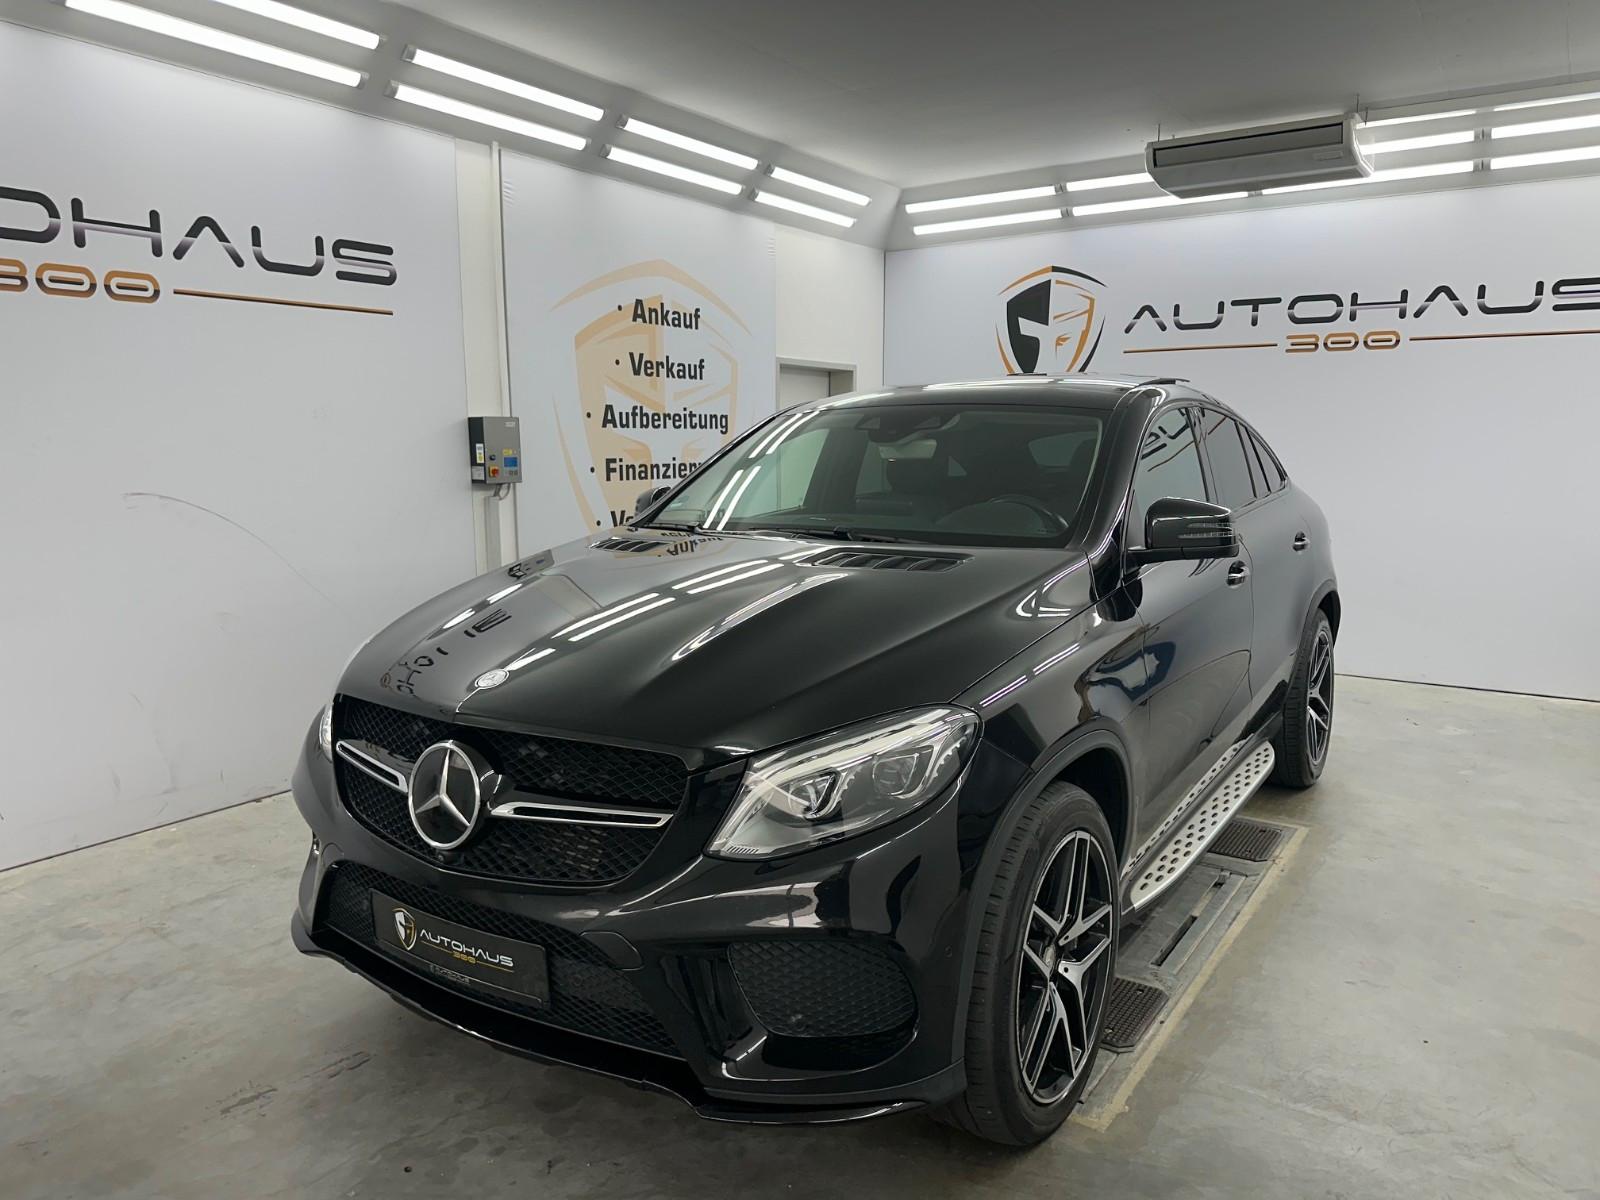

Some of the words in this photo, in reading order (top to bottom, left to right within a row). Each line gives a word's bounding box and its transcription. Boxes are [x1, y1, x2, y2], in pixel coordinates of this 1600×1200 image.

[631, 298, 700, 330] Ankauf
[1123, 277, 1600, 334] AUTOHAUS
[1284, 330, 1401, 354] 300
[628, 352, 705, 381] Verkauf
[601, 404, 729, 435] Aufbereitung
[605, 457, 702, 481] Finanzier
[419, 929, 514, 967] AUTOHAUS
